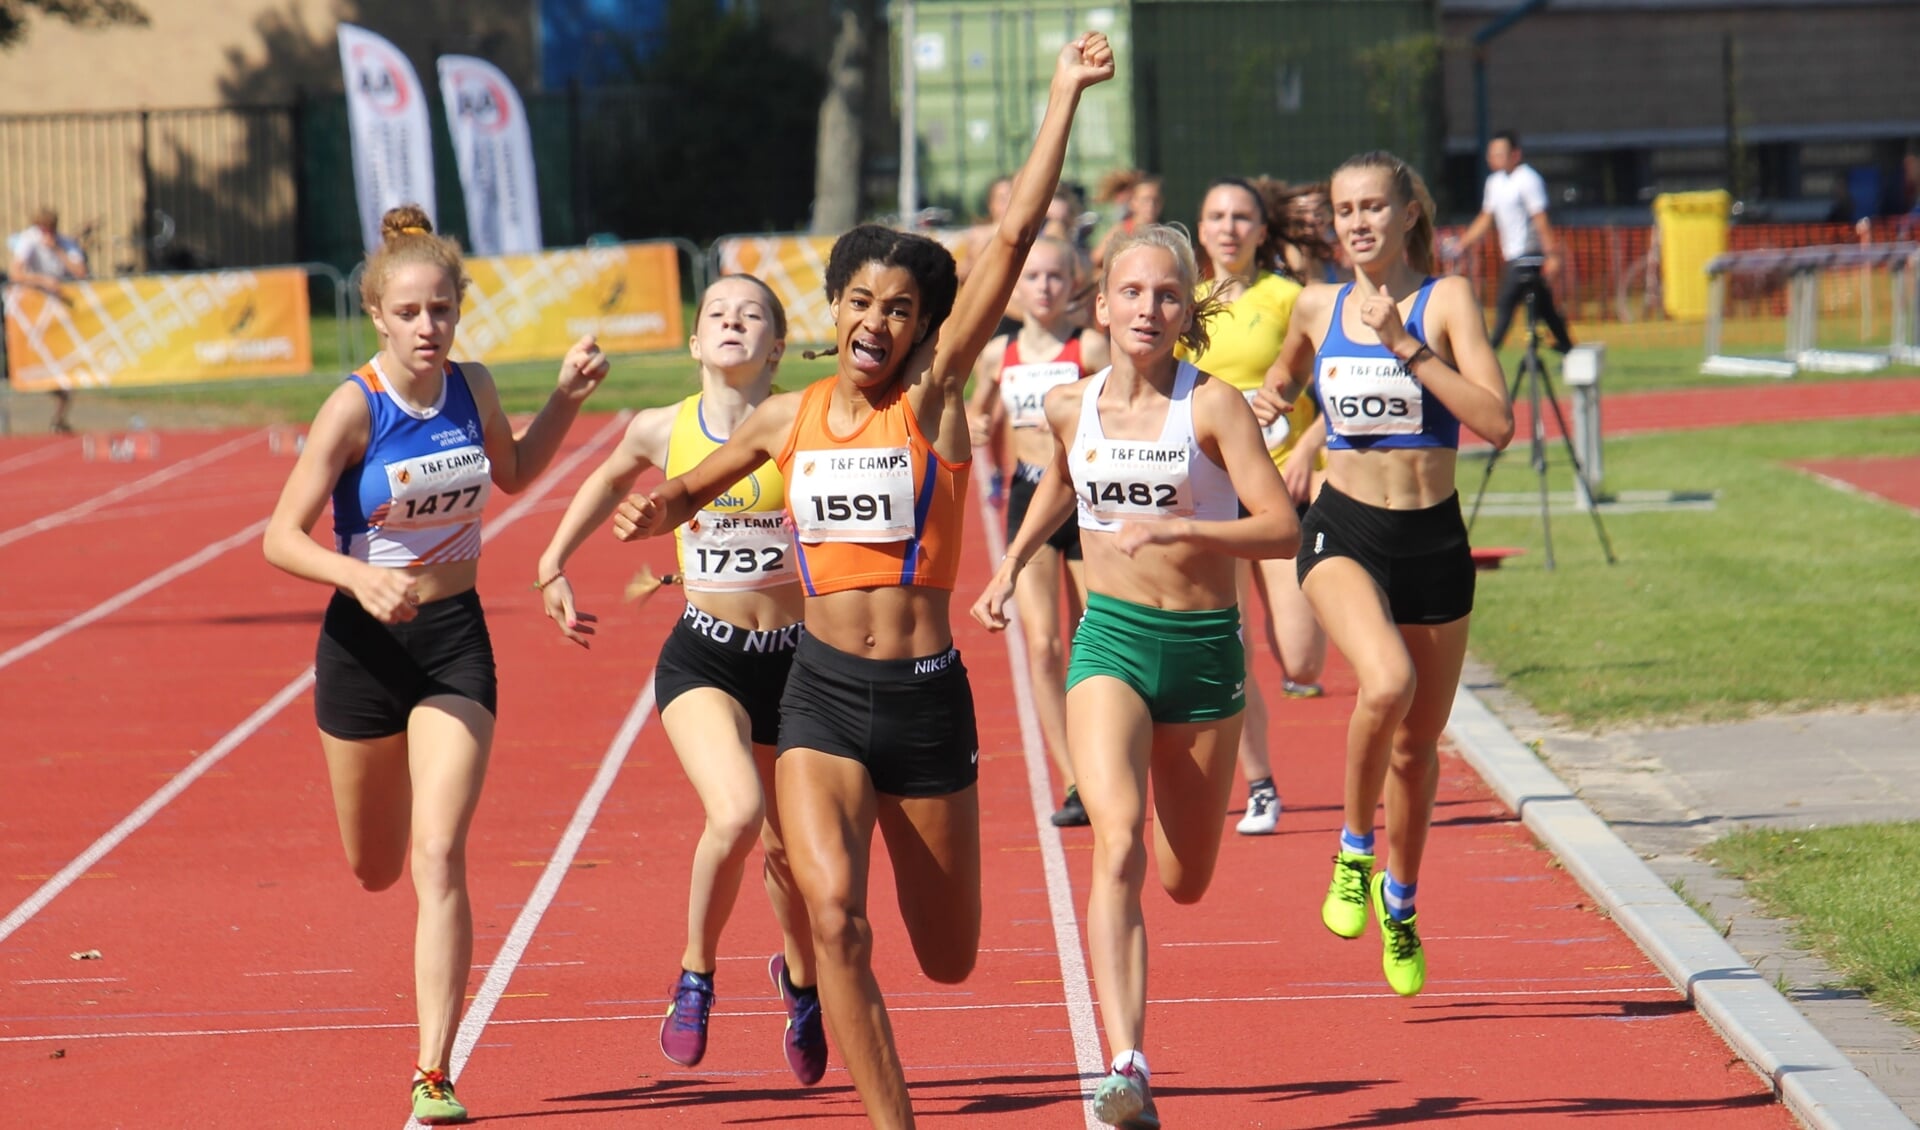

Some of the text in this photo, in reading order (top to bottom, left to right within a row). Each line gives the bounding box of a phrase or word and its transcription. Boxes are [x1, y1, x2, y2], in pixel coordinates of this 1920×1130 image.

[1329, 396, 1409, 418] 1603
[420, 462, 444, 475] T&F
[446, 452, 486, 470] CAMPS
[830, 455, 908, 470] T&F CAMPS
[1111, 448, 1186, 462] T&F CAMPS
[405, 484, 481, 519] 1477
[1086, 481, 1178, 508] 1482
[810, 494, 892, 522] 1591
[744, 517, 784, 529] CAMP
[696, 546, 784, 574] 1732
[683, 601, 734, 644] PRO
[914, 655, 948, 675] NIKE
